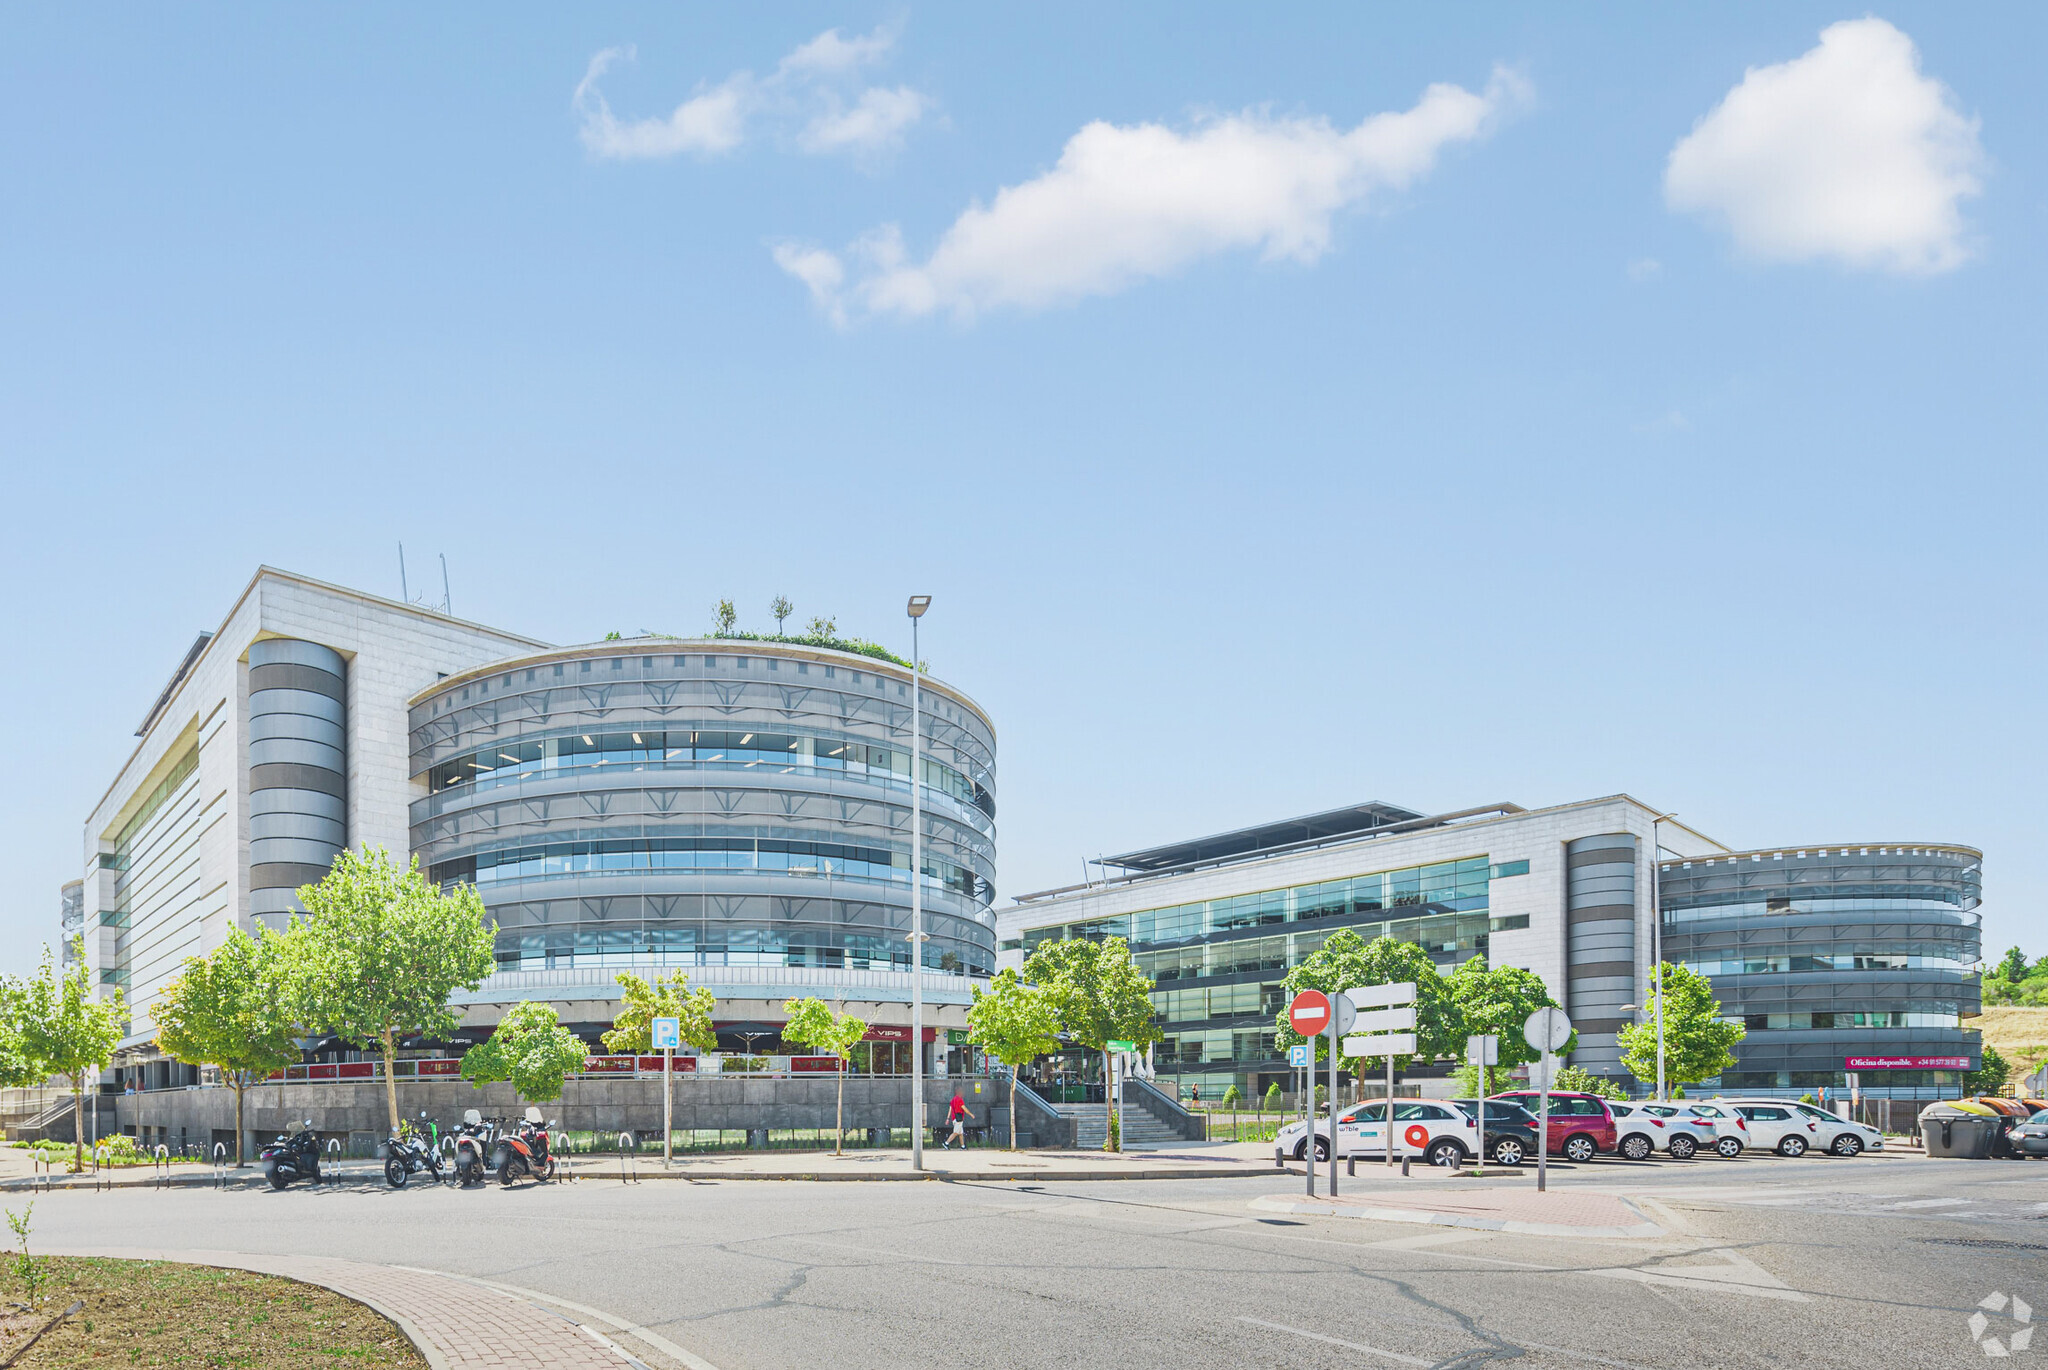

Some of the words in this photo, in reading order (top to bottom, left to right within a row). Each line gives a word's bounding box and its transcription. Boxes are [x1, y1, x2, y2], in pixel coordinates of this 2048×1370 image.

[657, 1021, 673, 1045] P
[1292, 1048, 1305, 1065] P
[1850, 1058, 1877, 1066] Oficina
[1877, 1058, 1913, 1068] disponible.
